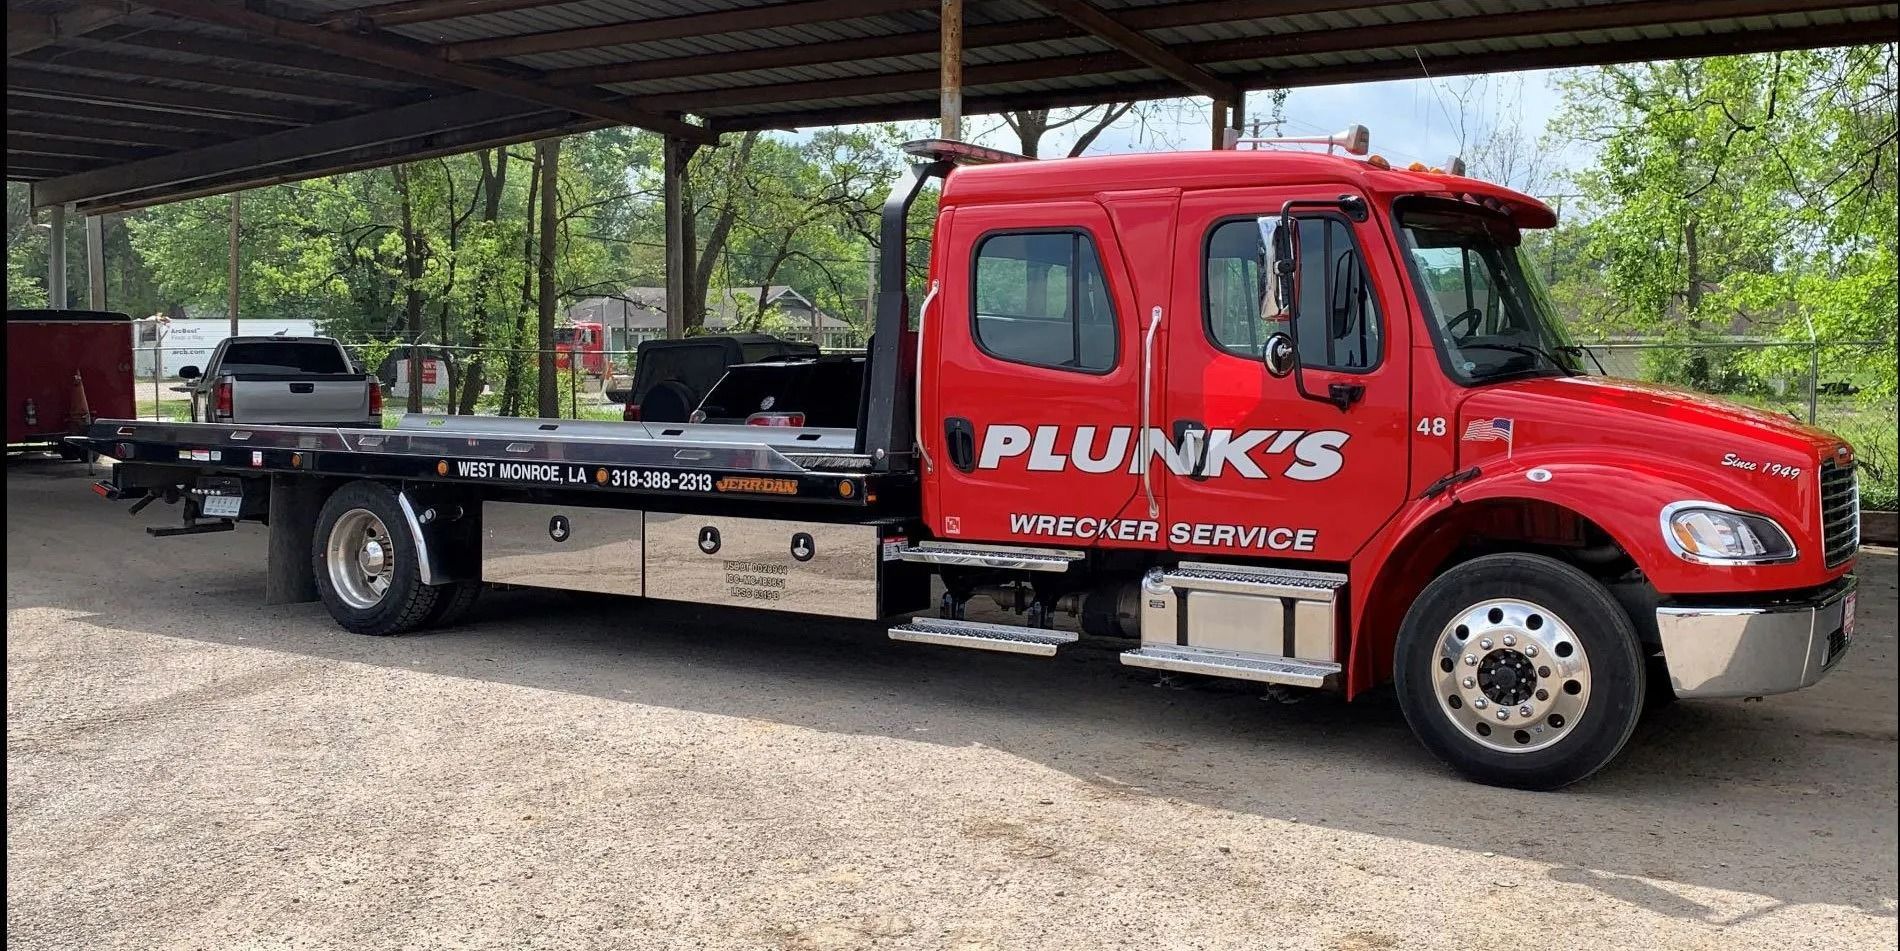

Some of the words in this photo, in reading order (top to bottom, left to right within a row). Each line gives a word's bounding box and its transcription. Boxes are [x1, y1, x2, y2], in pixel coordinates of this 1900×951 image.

[1416, 417, 1447, 436] 48
[978, 425, 1351, 482] PLUNK'S
[458, 461, 496, 477] WEST
[500, 463, 564, 484] MONROE,
[568, 467, 587, 483] LA
[1721, 453, 1757, 471] Since
[1762, 462, 1801, 480] 1949
[611, 469, 712, 491] 318-388-2313
[1010, 513, 1160, 542] WRECKER
[1169, 521, 1317, 551] SERVICE
